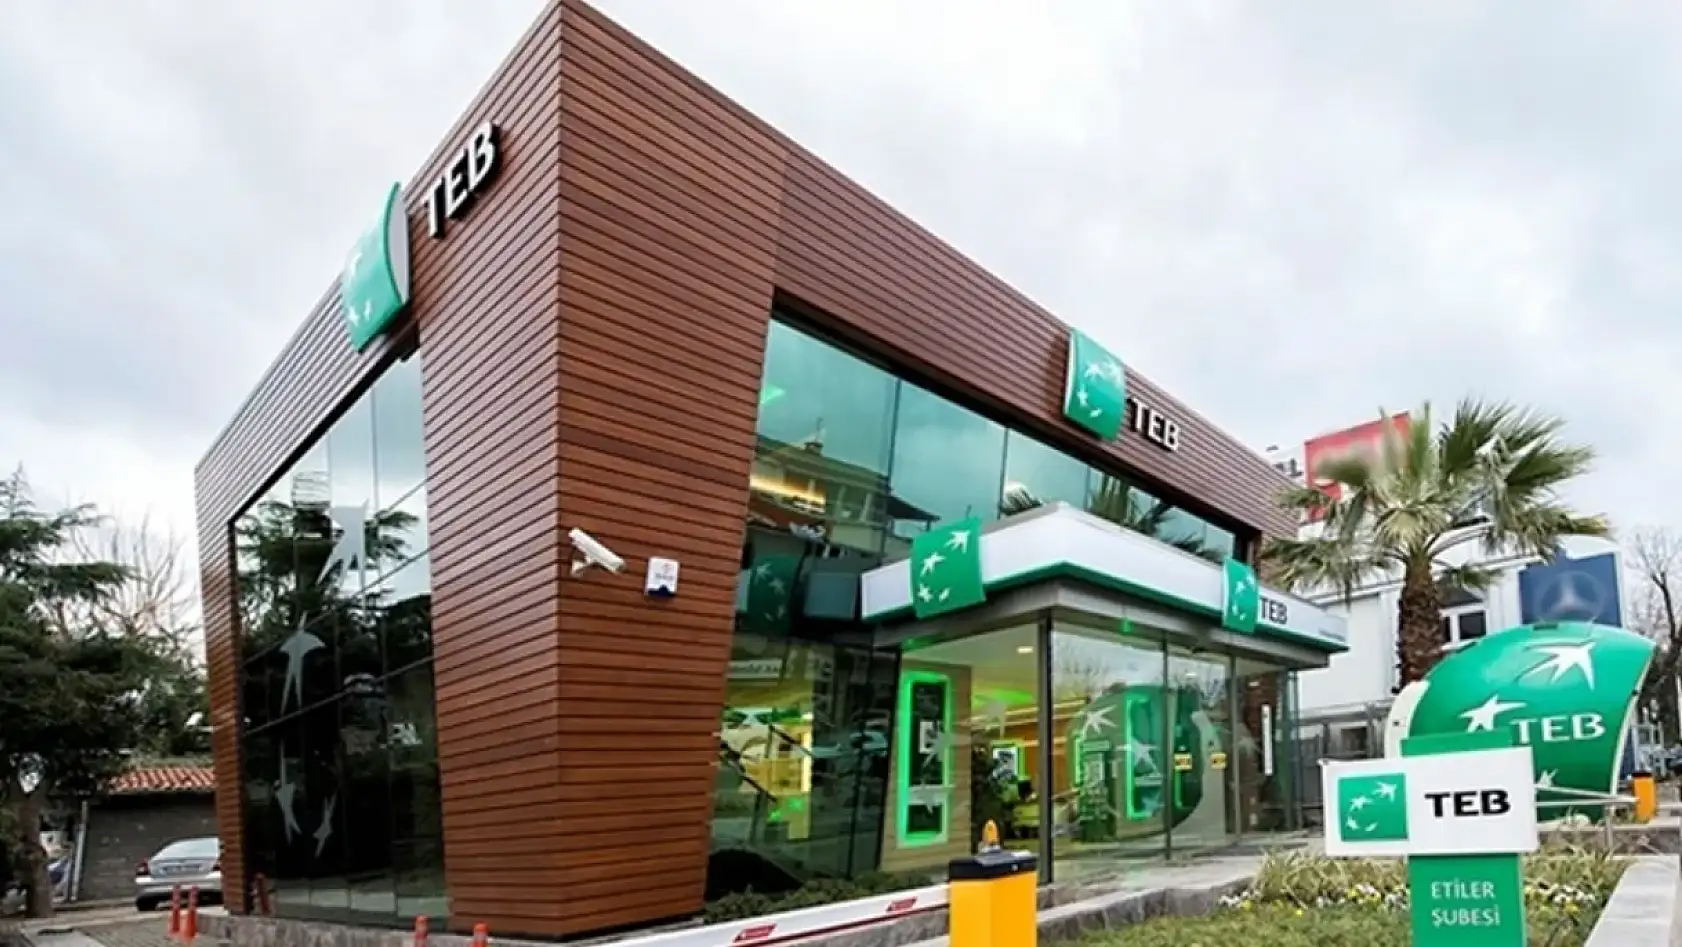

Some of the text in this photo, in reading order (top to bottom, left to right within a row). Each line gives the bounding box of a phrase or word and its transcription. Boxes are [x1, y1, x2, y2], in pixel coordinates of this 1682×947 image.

[420, 121, 497, 239] TEB
[1129, 397, 1179, 451] TEB
[1509, 712, 1606, 744] TEB
[1424, 789, 1511, 818] TEB
[1430, 878, 1496, 900] ETİLER
[1431, 904, 1501, 928] ŞUBESİ
